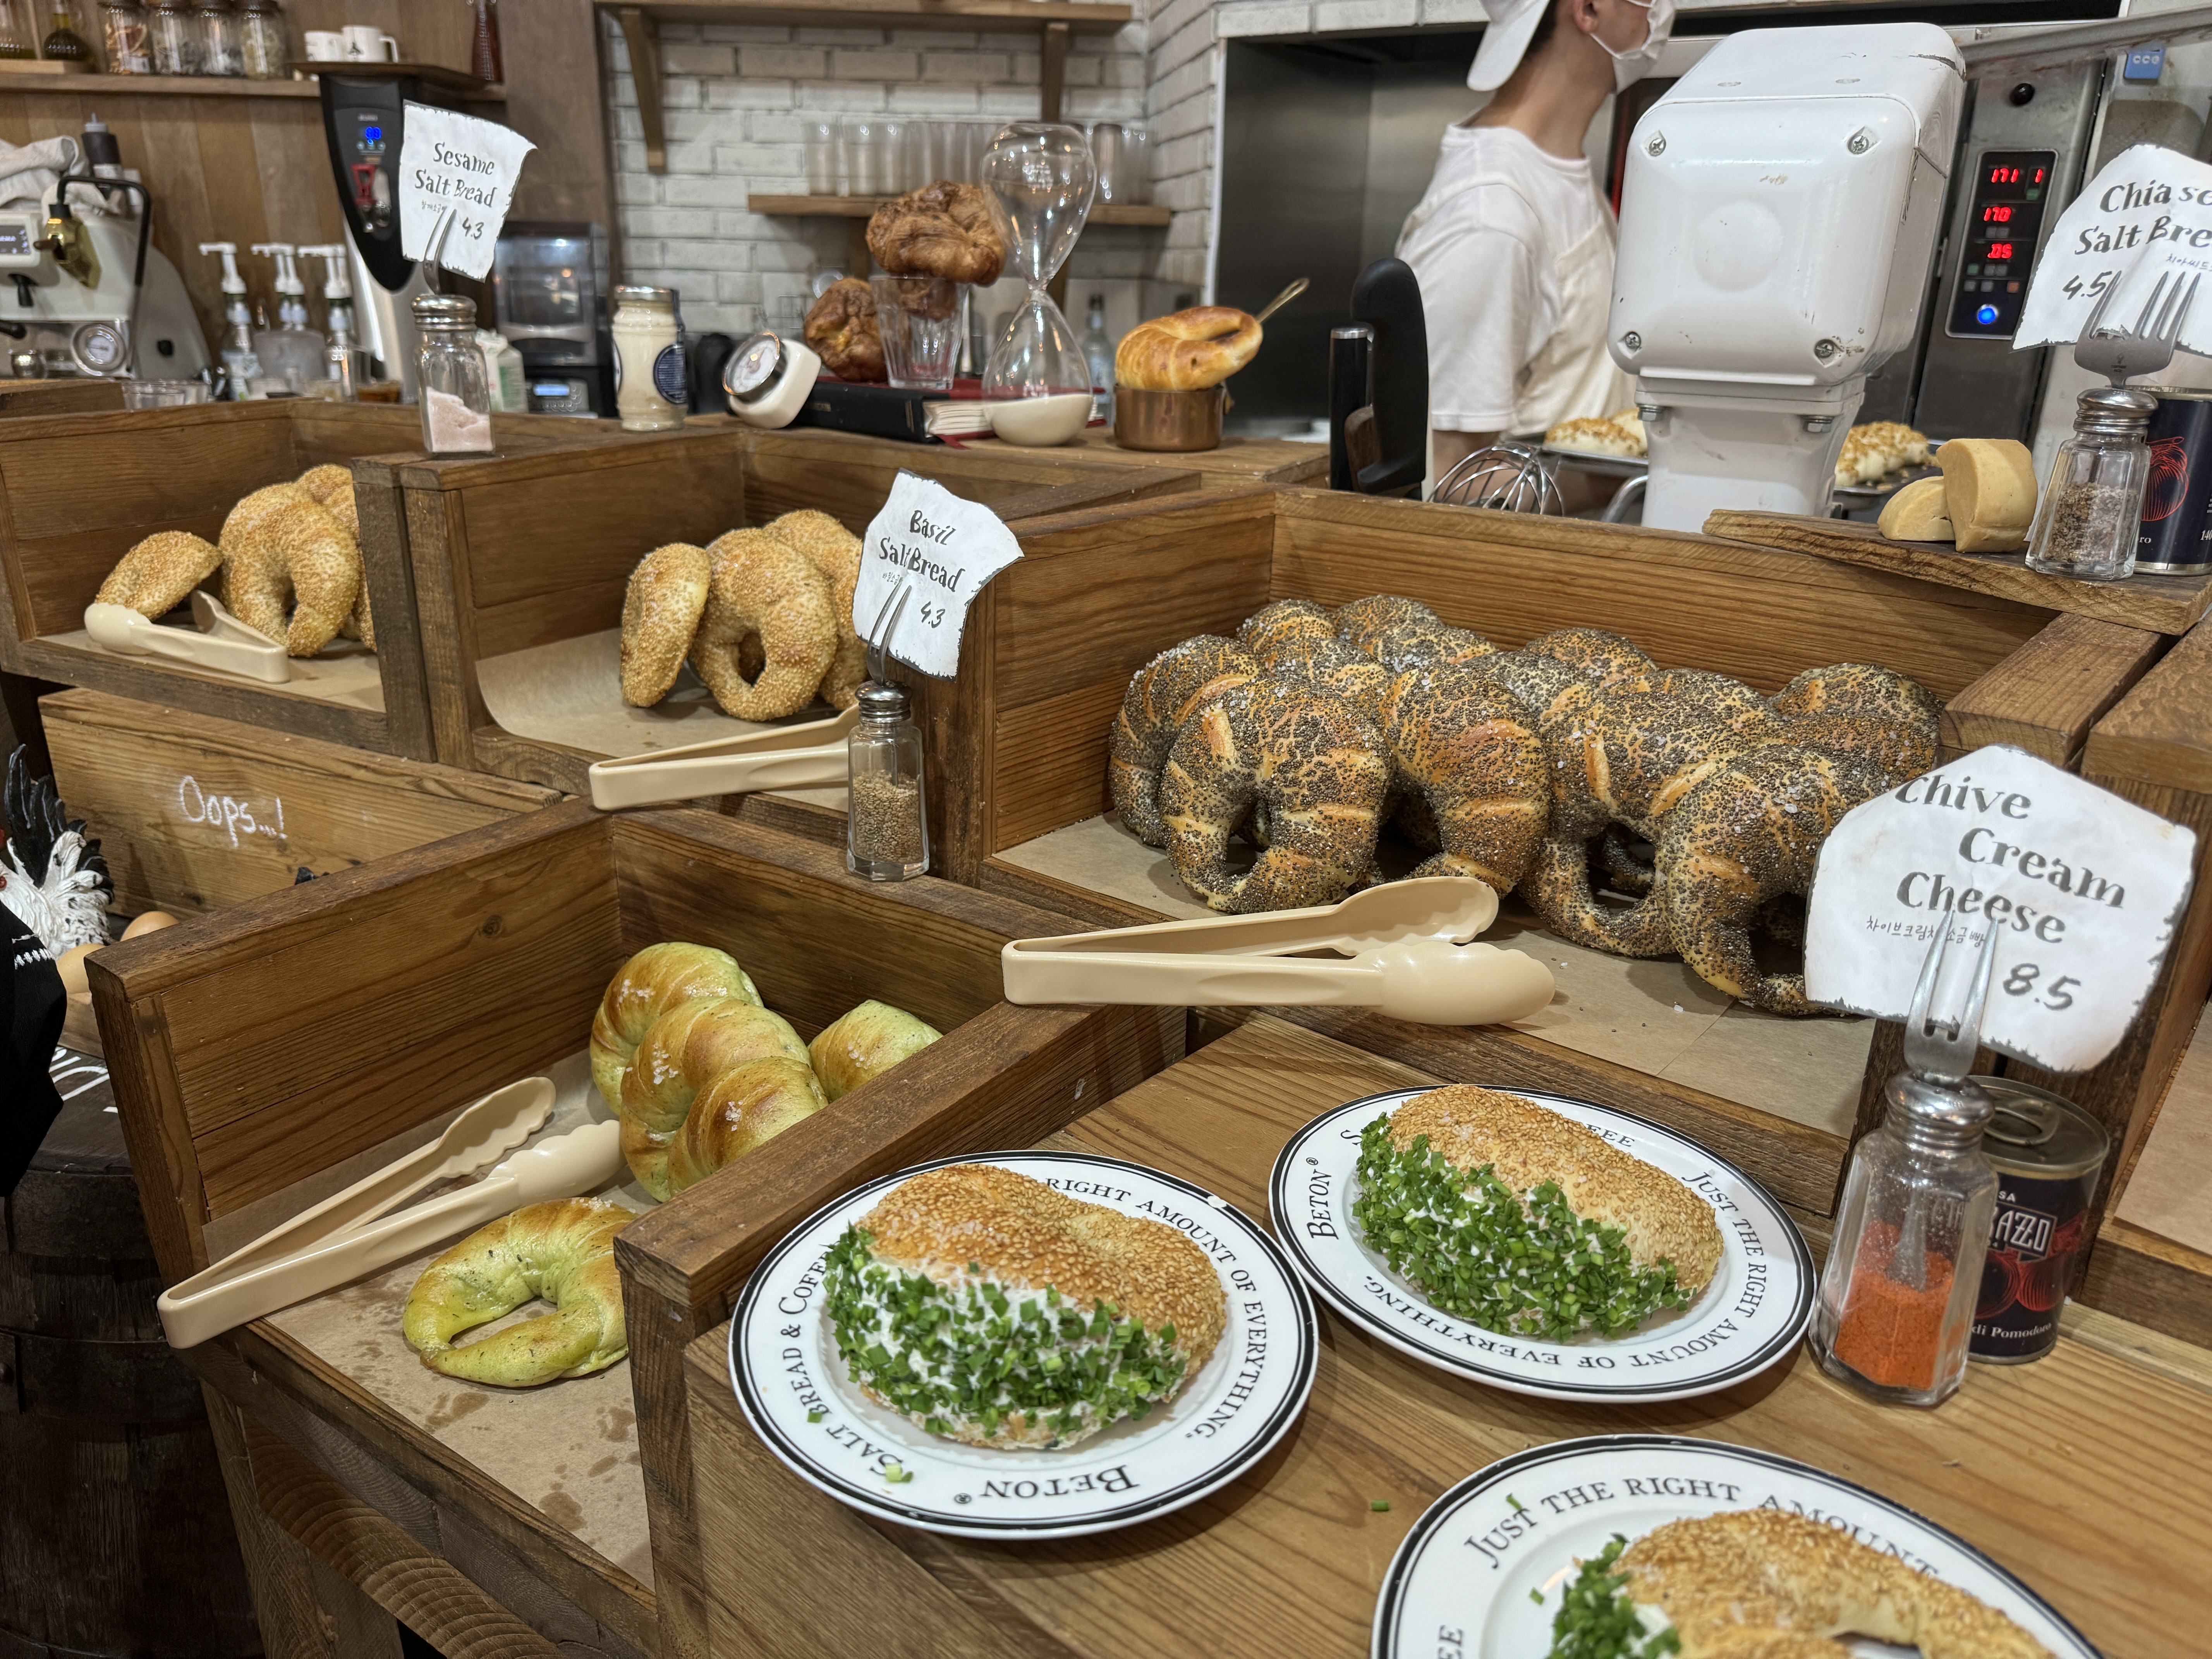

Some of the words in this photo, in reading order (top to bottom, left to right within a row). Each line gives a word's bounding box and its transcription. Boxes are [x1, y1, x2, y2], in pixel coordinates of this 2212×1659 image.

[433, 142, 495, 175] Sesame
[415, 169, 451, 195] Salt
[454, 179, 498, 208] Bread
[2100, 179, 2172, 213] Chia
[462, 216, 484, 240] 4.3
[2074, 224, 2142, 255] Salt
[2062, 271, 2112, 300] 4.5
[909, 510, 957, 545] Basil
[920, 601, 946, 629] 4.3
[1894, 773, 2032, 821] Chive
[1957, 825, 2126, 910] Cream
[1895, 870, 2068, 946] Cheese
[2002, 962, 2082, 1012] 8.5
[1045, 1177, 1132, 1201] RIGHT
[1136, 1200, 1237, 1265] AMOUNT
[1732, 1218, 1764, 1257] THE
[1230, 1269, 1257, 1293] OF
[1734, 1263, 1767, 1319] RIGHT
[780, 1324, 801, 1338] &
[1364, 1276, 1562, 1365] EVERYTHING.
[1991, 1322, 2052, 1339] Pomodoro
[1630, 1317, 1740, 1368] AMOUNT
[782, 1347, 833, 1415] BREAD
[1185, 1300, 1267, 1439] EVERYTHING.
[1577, 1356, 1616, 1369] OF
[826, 1424, 903, 1476] SALT
[1540, 1481, 1615, 1514] THE
[1622, 1477, 1741, 1502] RIGHT
